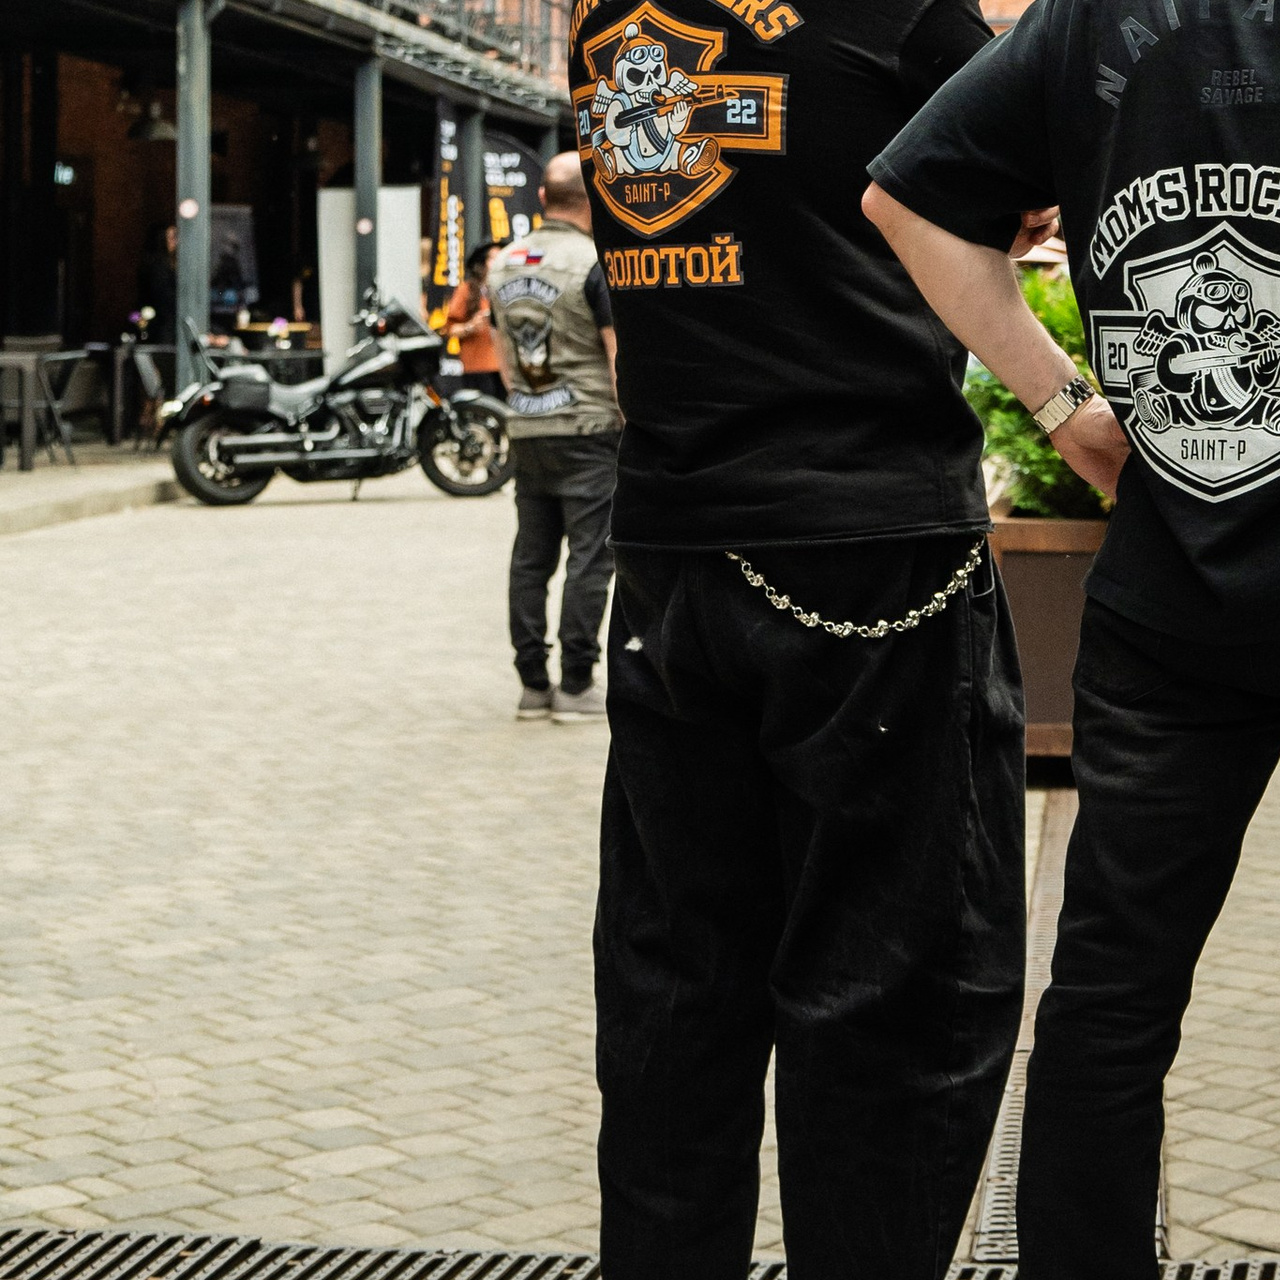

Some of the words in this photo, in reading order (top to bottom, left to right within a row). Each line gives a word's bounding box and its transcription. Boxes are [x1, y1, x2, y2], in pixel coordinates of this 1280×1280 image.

[1210, 68, 1258, 87] REBEL
[1200, 86, 1265, 106] SAVAGE
[578, 110, 590, 136] 20
[726, 98, 757, 125] 22
[624, 183, 671, 204] SAINT-P
[1090, 167, 1191, 280] MOM'S
[604, 235, 743, 288] ЗОЛОТОЙ
[1107, 342, 1129, 370] 20
[1180, 438, 1247, 461] SAINT-P
